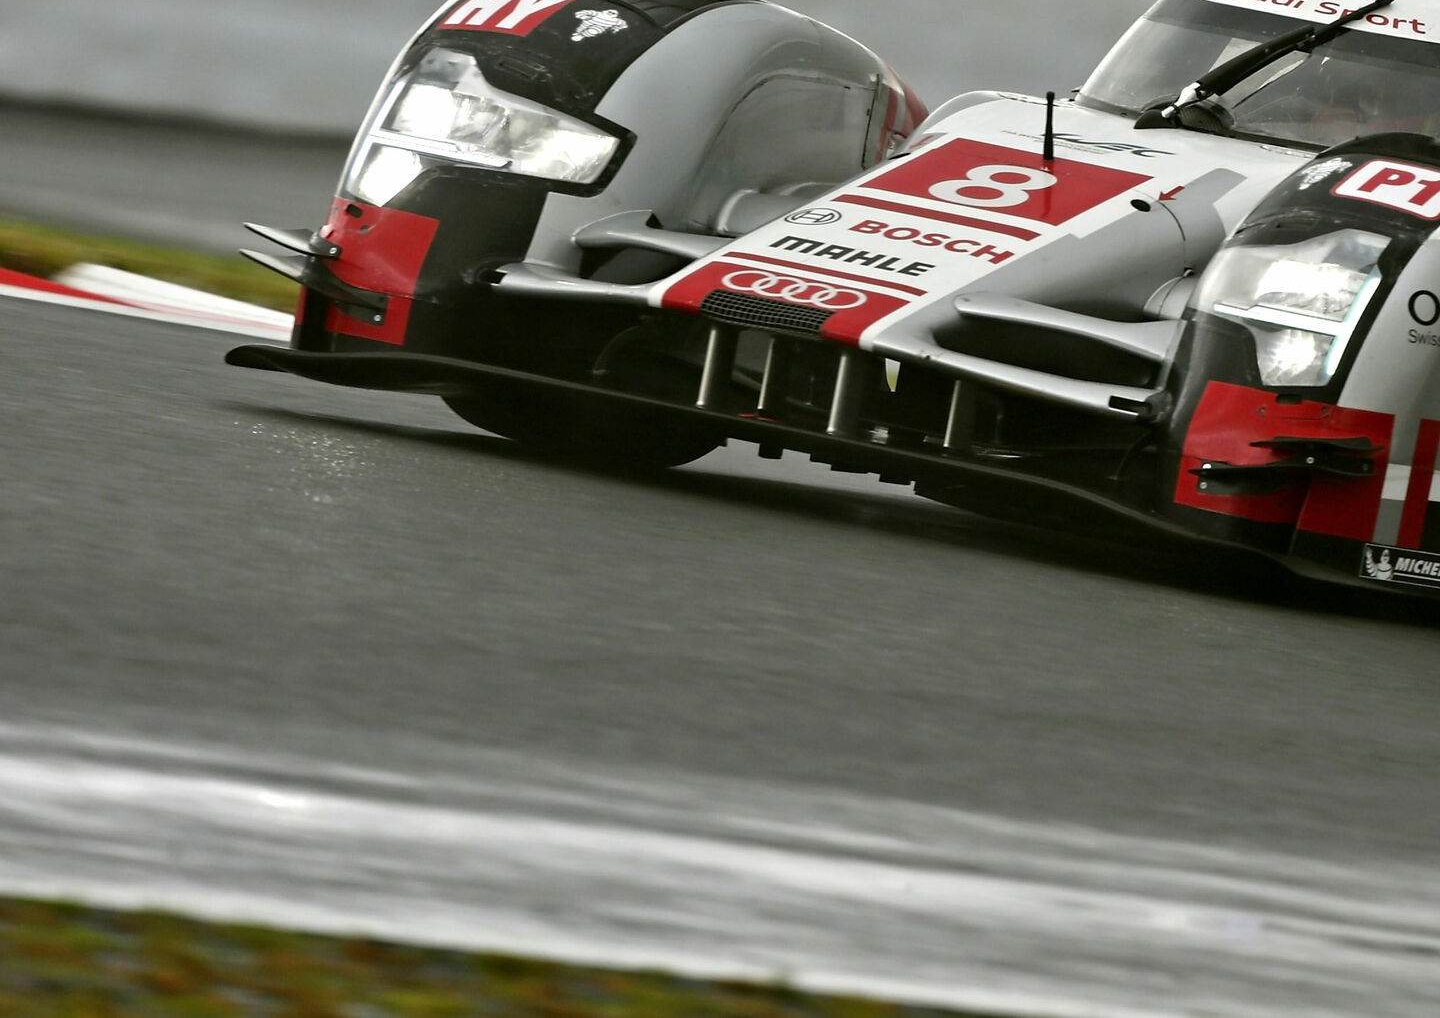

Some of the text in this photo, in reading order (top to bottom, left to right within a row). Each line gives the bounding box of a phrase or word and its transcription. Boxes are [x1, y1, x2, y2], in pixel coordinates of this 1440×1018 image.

[1315, 1, 1426, 34] Sort
[928, 164, 1058, 208] 8
[769, 235, 936, 276] MAHLE
[848, 219, 1015, 265] BOSCH
